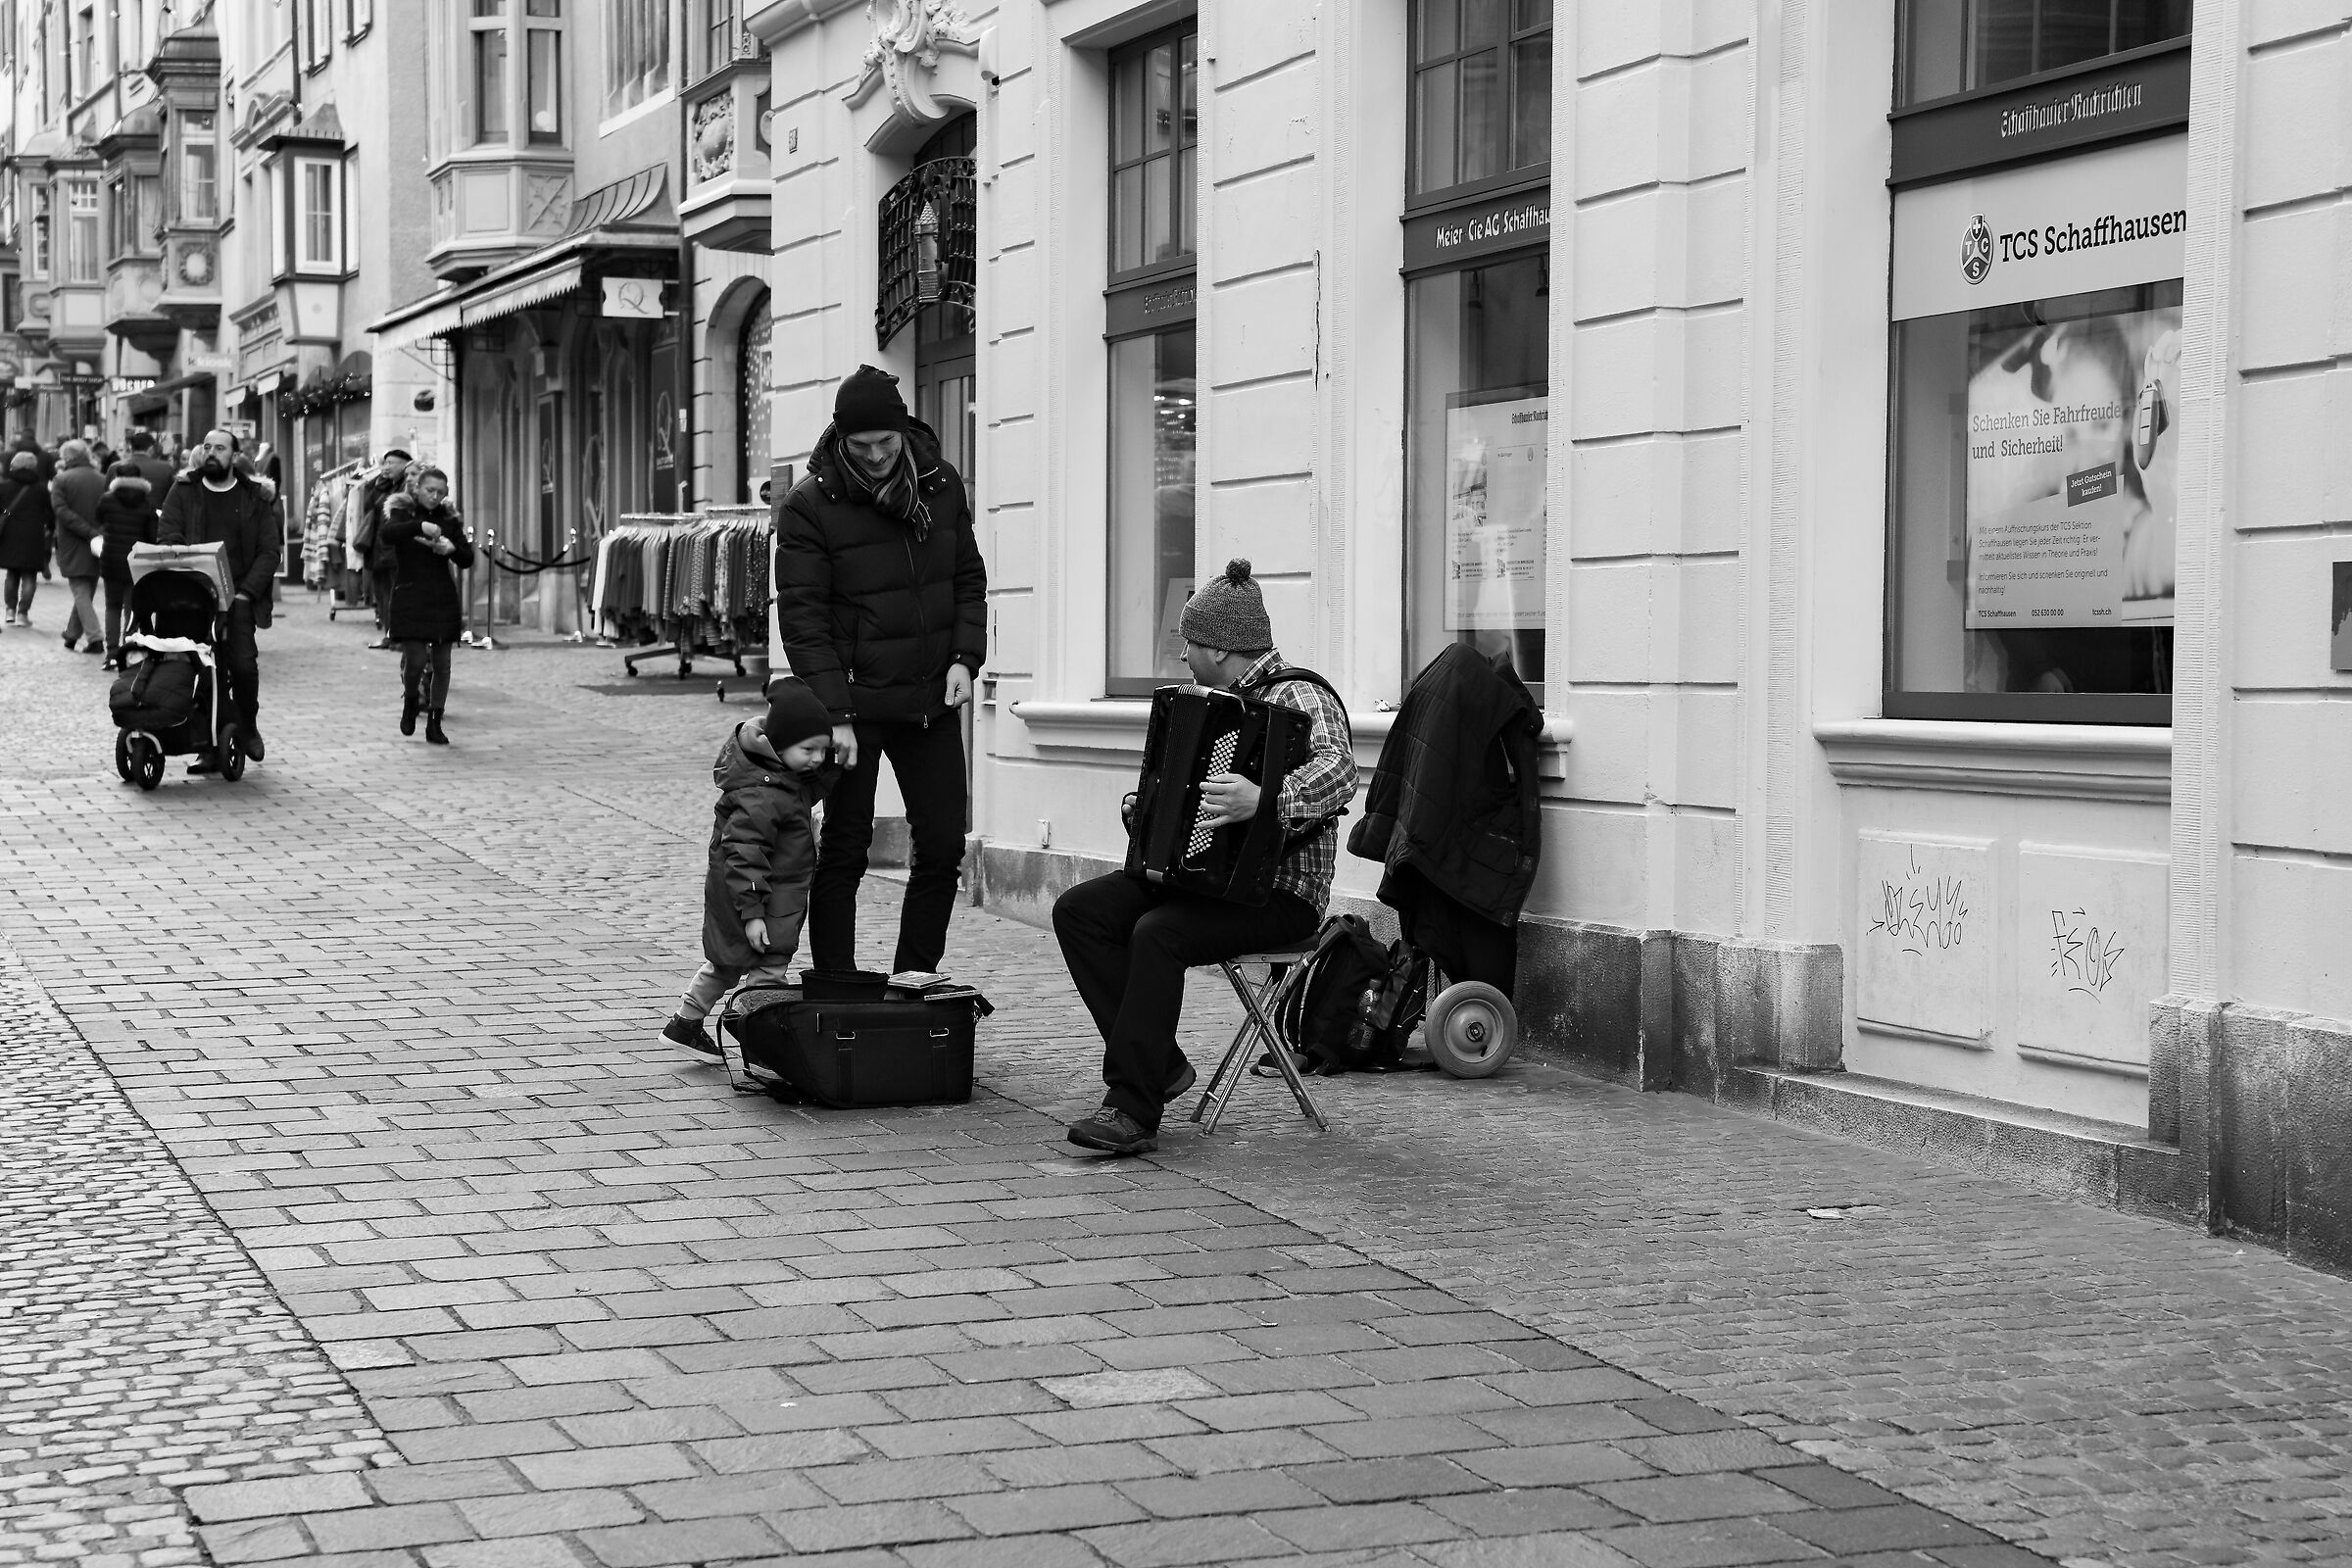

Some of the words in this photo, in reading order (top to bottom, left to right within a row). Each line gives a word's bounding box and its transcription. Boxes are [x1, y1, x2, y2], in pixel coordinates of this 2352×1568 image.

[2071, 83, 2142, 121] Nachrichten
[1436, 224, 1463, 249] Meier
[1468, 219, 1483, 241] Cie
[1484, 213, 1499, 238] AG
[1999, 228, 2038, 263] TCS
[2044, 209, 2186, 256] Schaffhausen
[1973, 412, 2030, 433] Schenken
[2033, 409, 2050, 427] Sie
[2053, 402, 2122, 425] Fahrfreude
[1972, 441, 1995, 460] und
[2000, 434, 2063, 458] Sicherheit!
[2070, 477, 2084, 488] Jetzt
[2084, 469, 2112, 484] Gutschein
[2082, 484, 2102, 497] kaufen!
[2060, 521, 2071, 530] TCS
